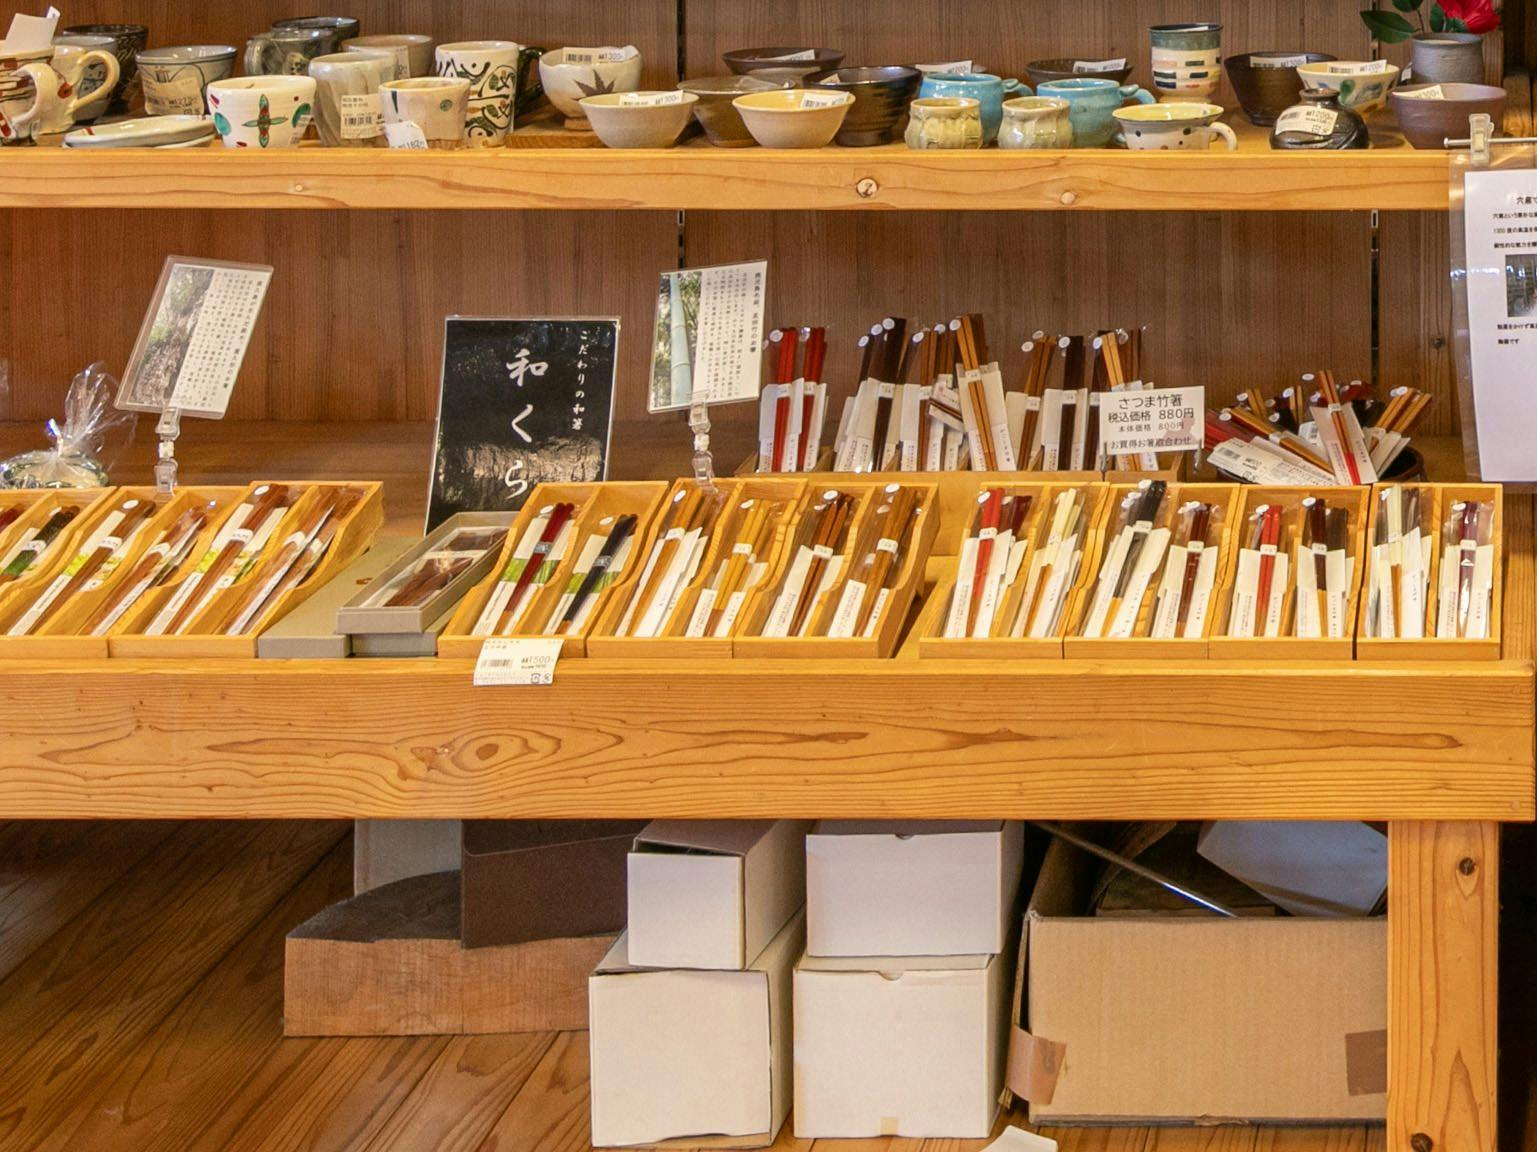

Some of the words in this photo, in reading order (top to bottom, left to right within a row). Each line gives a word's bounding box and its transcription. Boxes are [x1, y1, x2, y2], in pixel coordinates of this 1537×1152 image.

[571, 329, 590, 431] こだわりの和箸
[1119, 393, 1183, 410] さつま竹箸
[505, 348, 549, 500] 和くら
[1108, 410, 1152, 423] 税込価格
[1158, 407, 1195, 420] 880円
